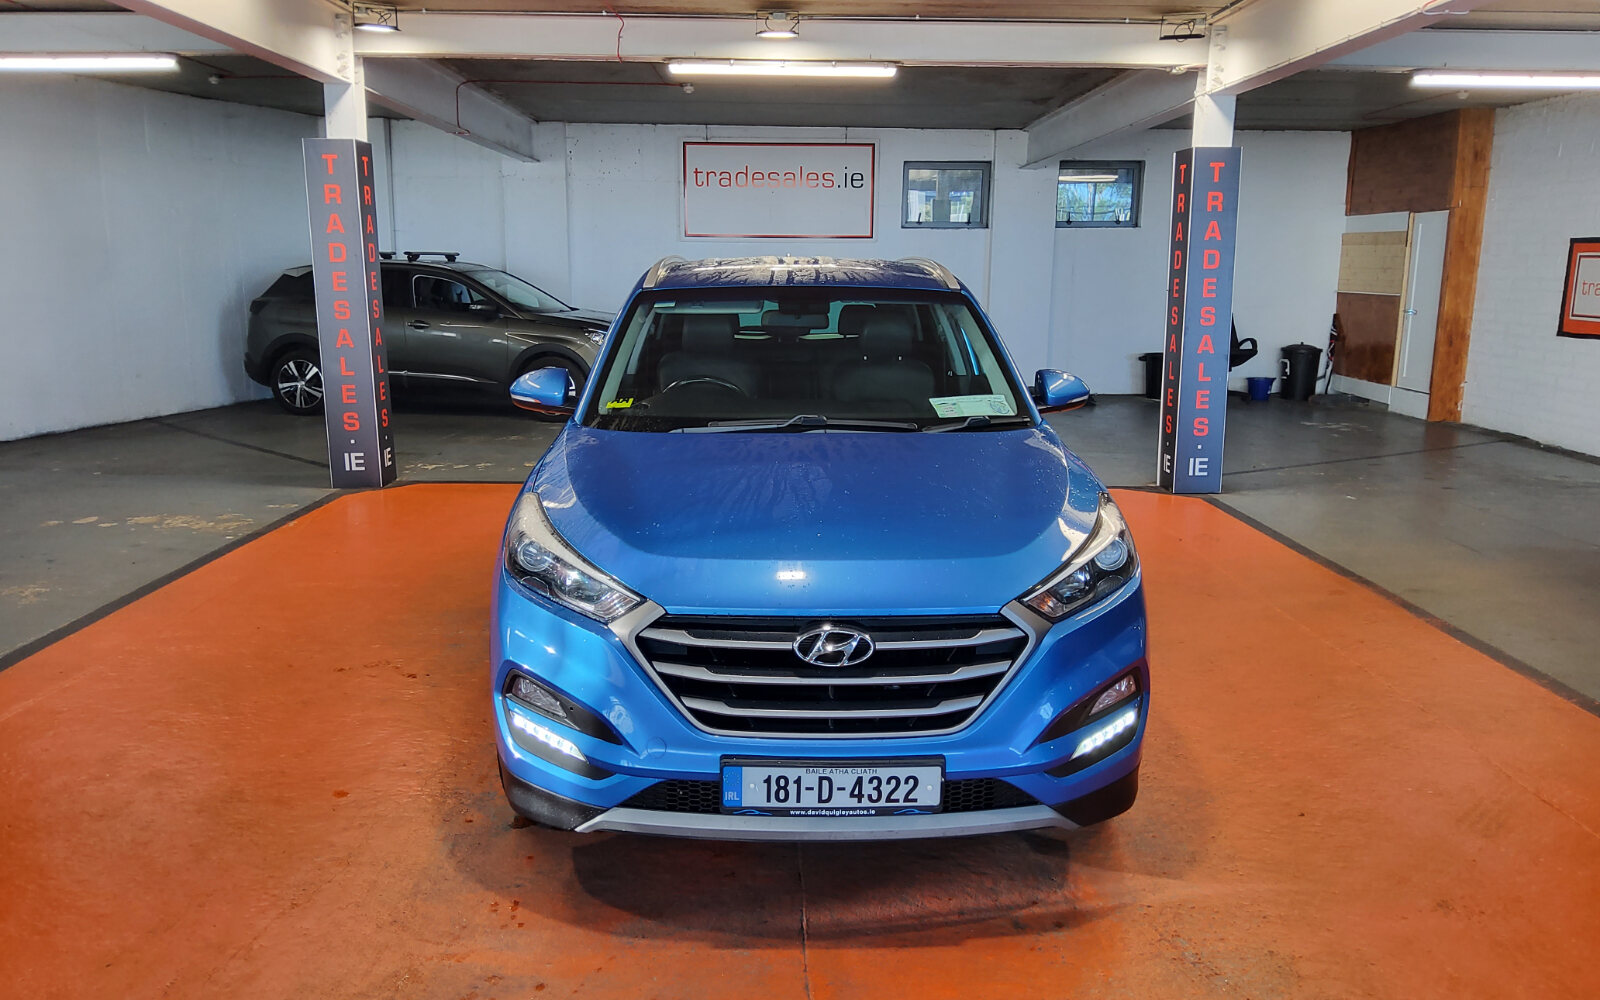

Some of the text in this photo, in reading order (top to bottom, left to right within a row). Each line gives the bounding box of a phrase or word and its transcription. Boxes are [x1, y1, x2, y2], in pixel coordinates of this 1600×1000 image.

[693, 165, 865, 189] tradesales.ie
[724, 791, 740, 801] IRL
[762, 774, 920, 804] 181-D-4322
